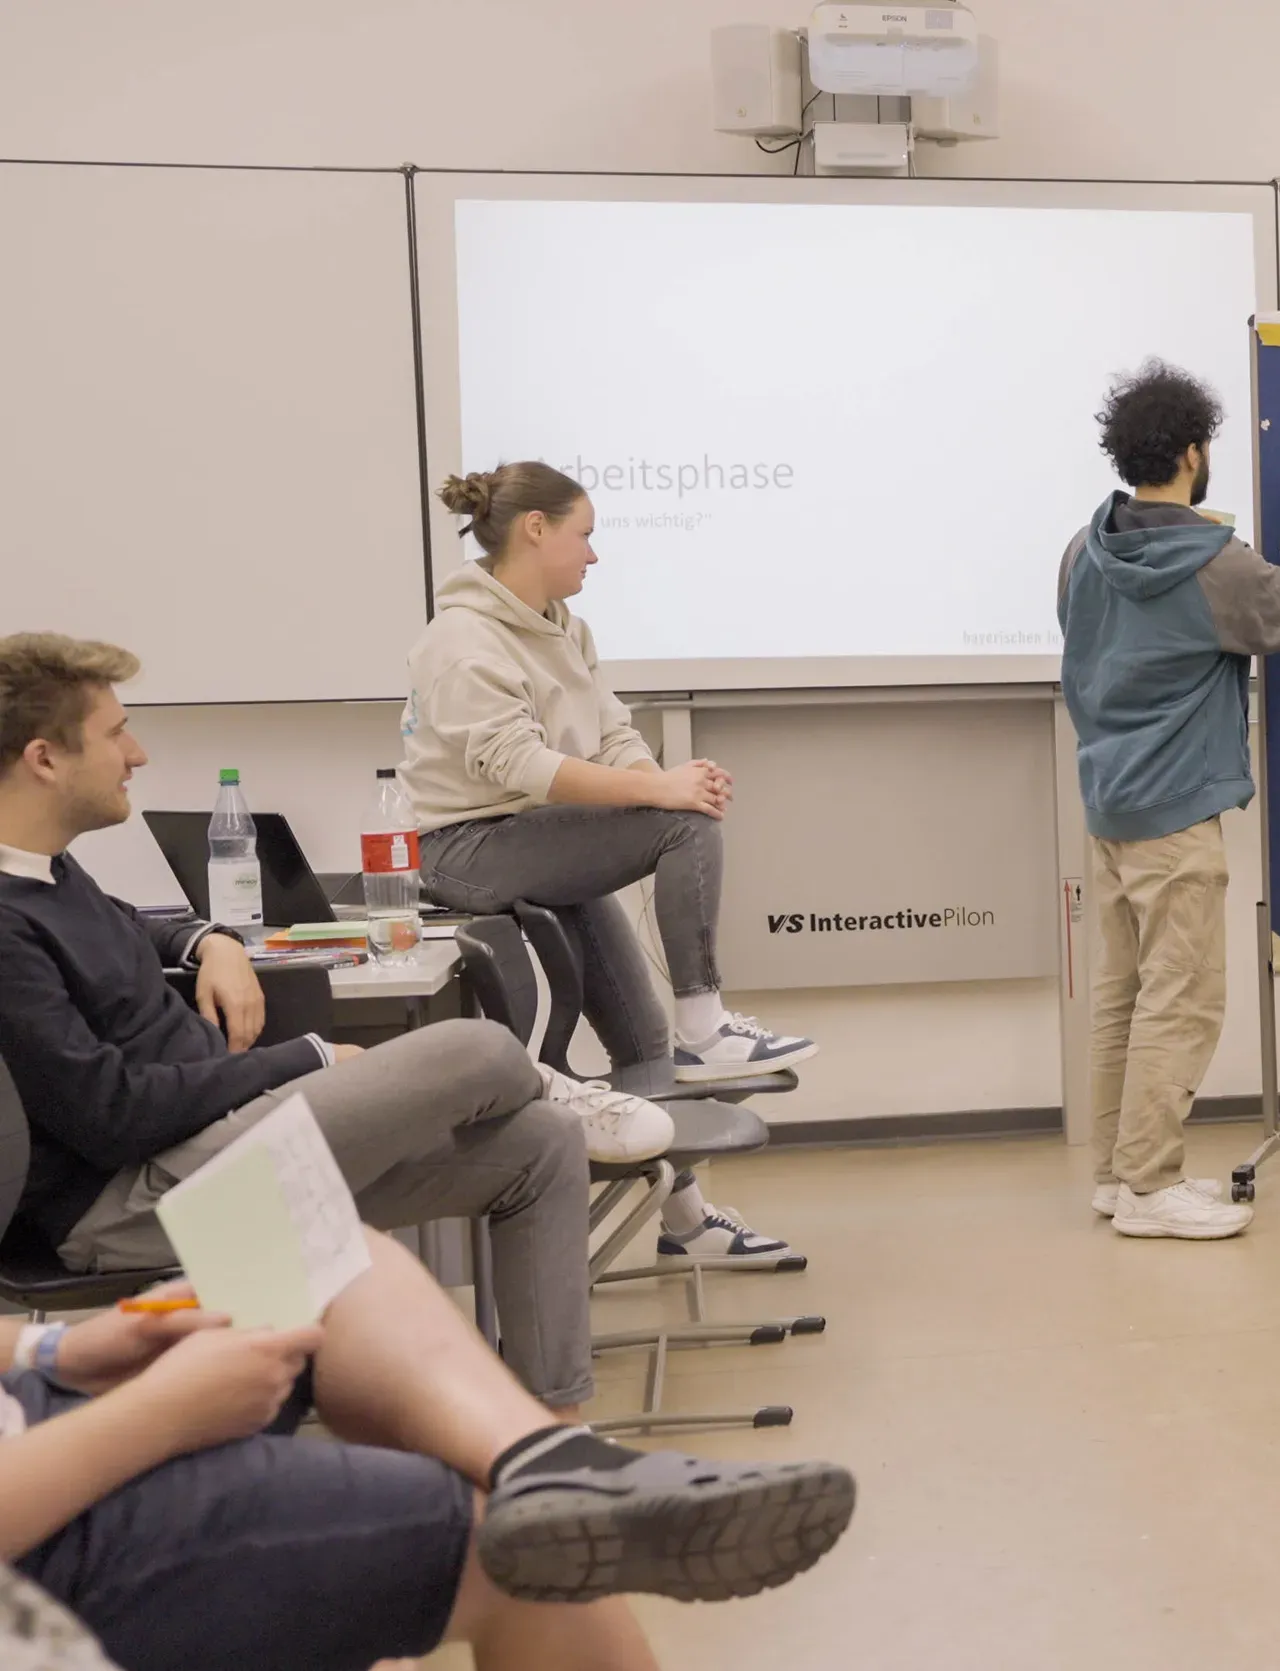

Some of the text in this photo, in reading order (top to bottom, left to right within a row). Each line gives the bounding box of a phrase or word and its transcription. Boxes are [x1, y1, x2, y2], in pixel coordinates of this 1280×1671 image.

[881, 14, 908, 23] EPSON
[600, 515, 630, 529] uns
[767, 913, 805, 934] VS
